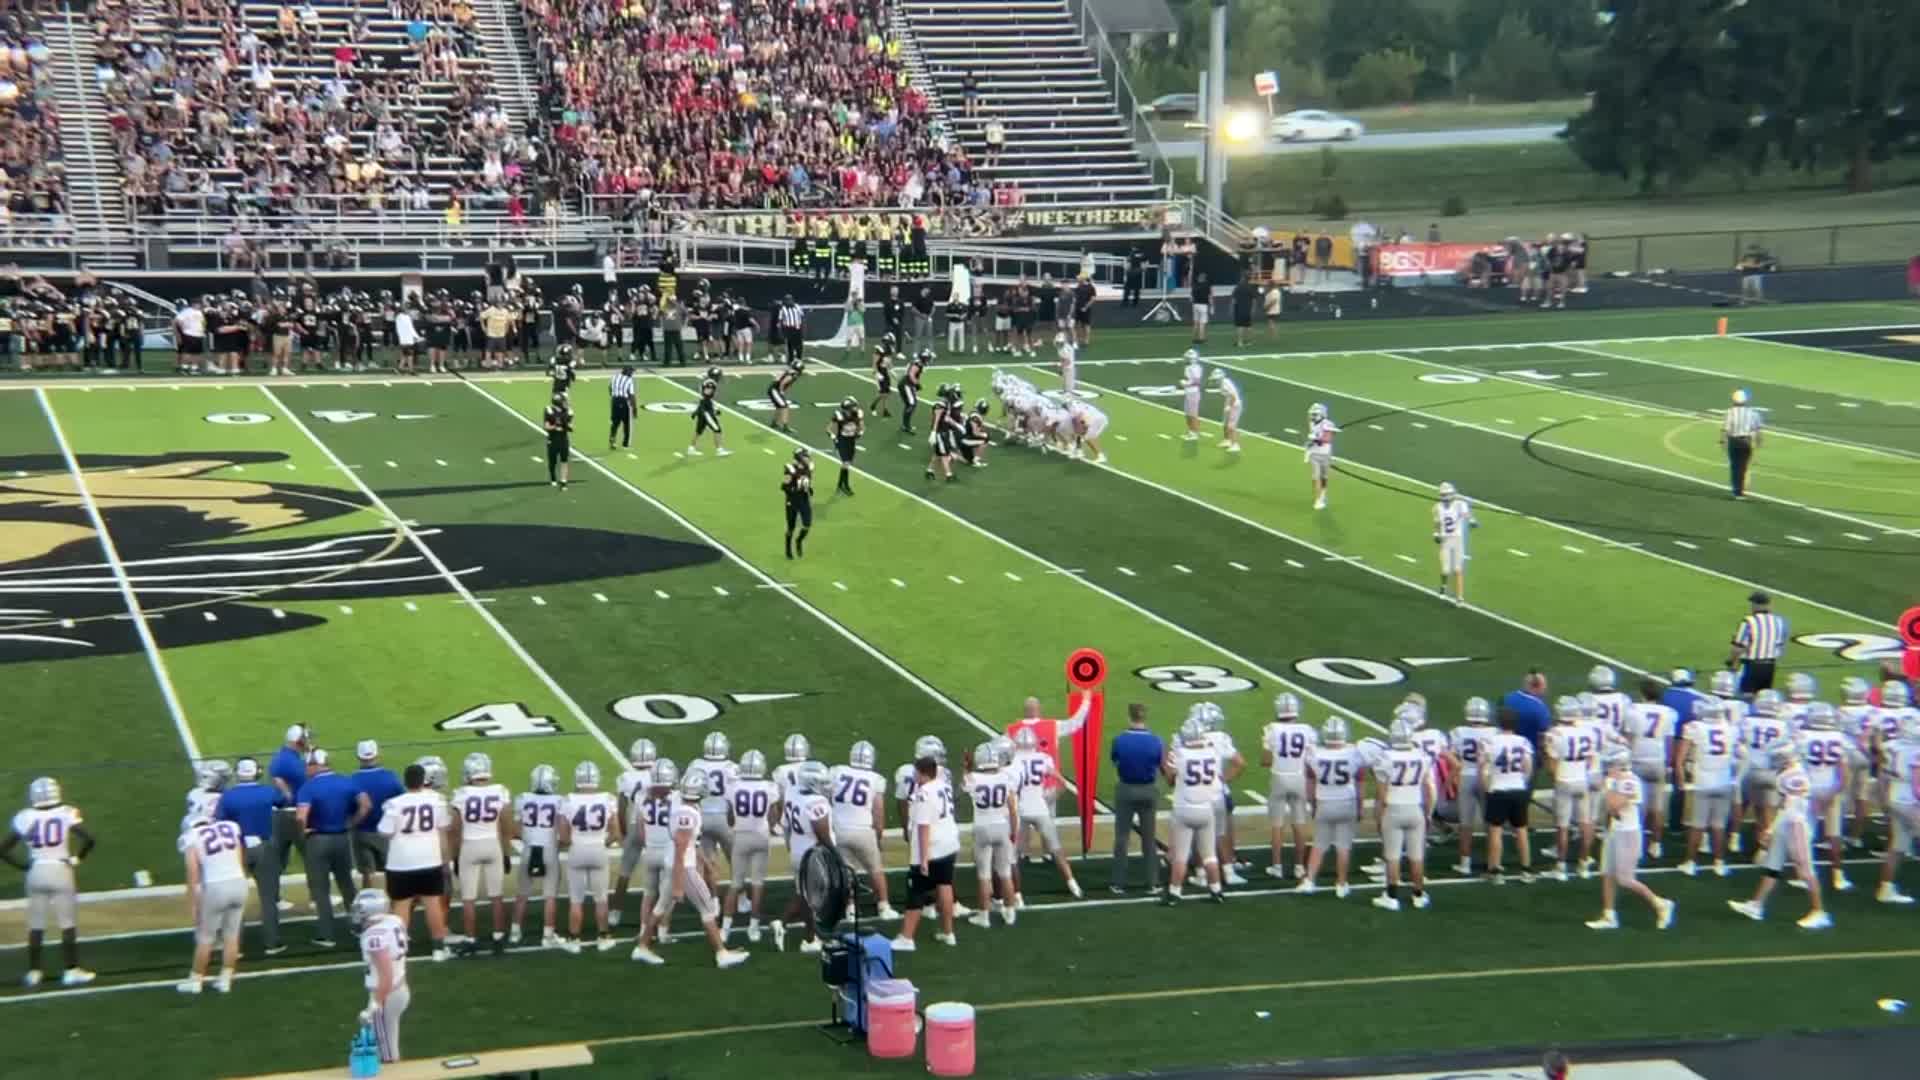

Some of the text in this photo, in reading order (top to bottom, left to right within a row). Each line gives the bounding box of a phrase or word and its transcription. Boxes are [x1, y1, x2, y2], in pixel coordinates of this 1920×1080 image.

[1379, 250, 1437, 270] BGSU
[1443, 516, 1455, 533] 2
[1645, 712, 1661, 738] 7
[1278, 731, 1305, 759] 19
[1564, 735, 1592, 762] 12
[1708, 729, 1728, 755] 5
[1184, 758, 1217, 787] 55
[1318, 760, 1351, 786] 75
[1391, 760, 1423, 787] 77
[733, 789, 769, 818] 80
[834, 773, 870, 807] 76
[975, 784, 1007, 810] 30
[399, 804, 435, 834] 78
[464, 795, 500, 823] 85
[522, 802, 556, 828] 33
[570, 804, 607, 831] 43
[27, 817, 64, 849] 40
[199, 824, 237, 856] 29
